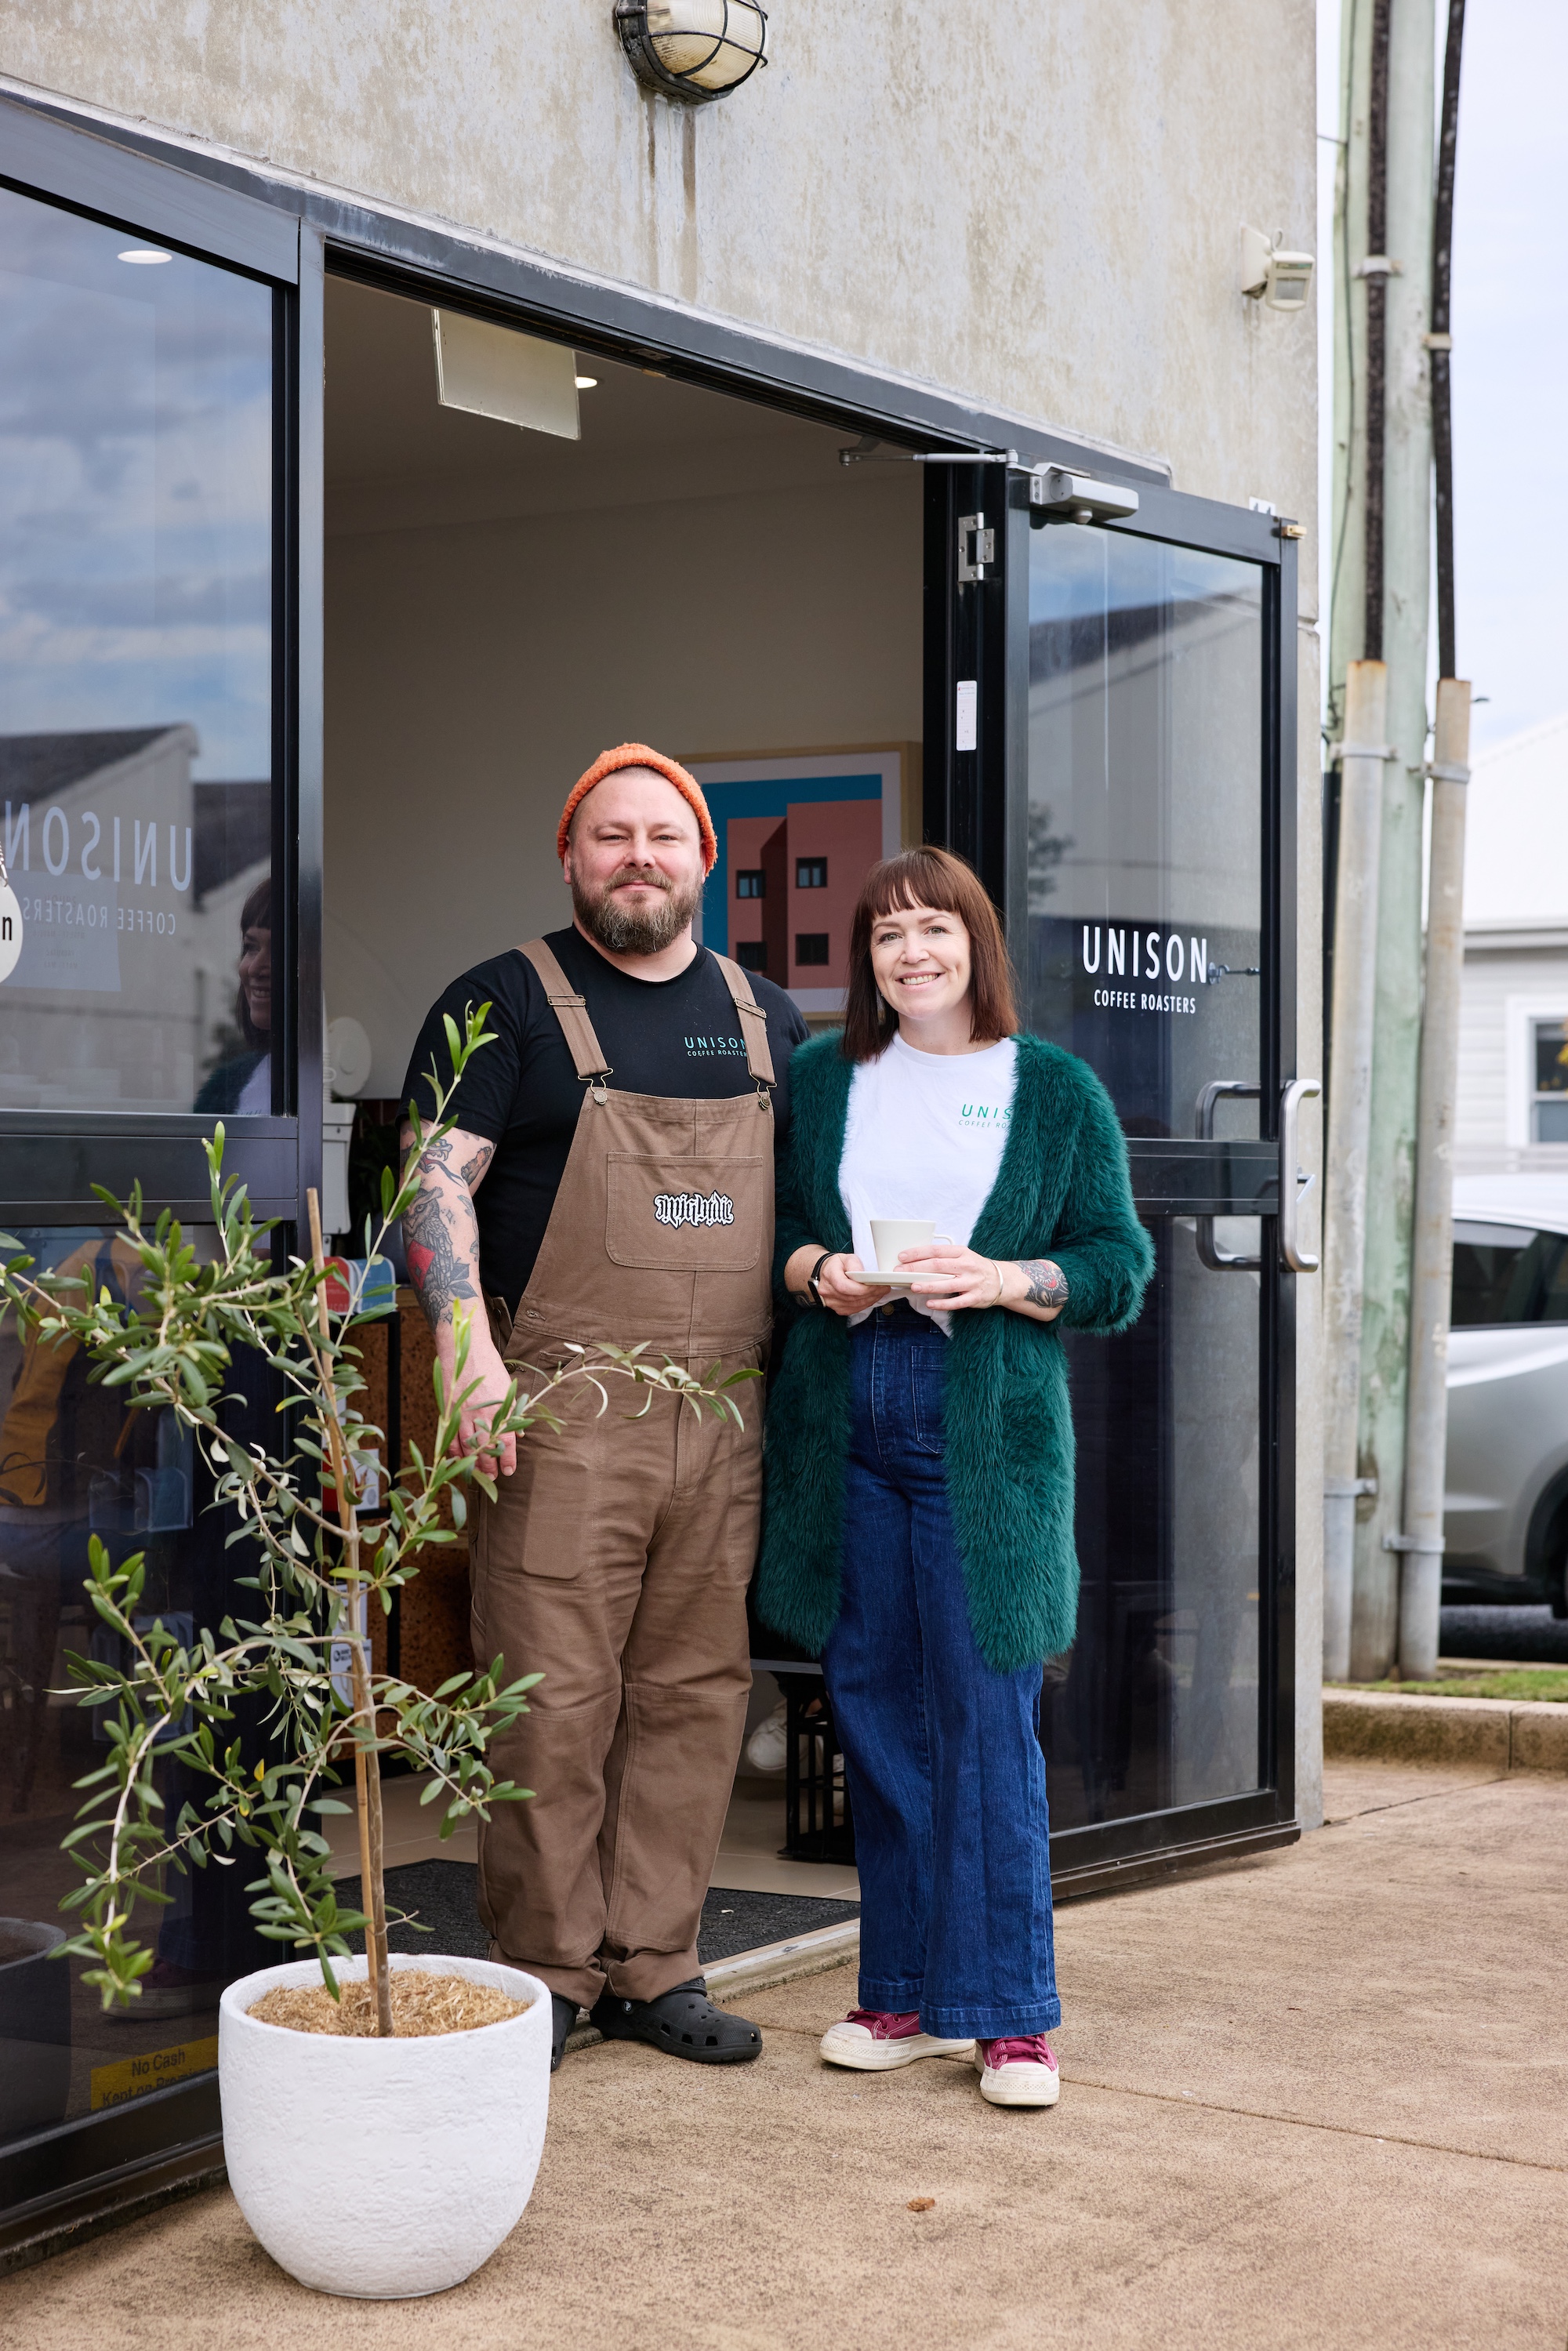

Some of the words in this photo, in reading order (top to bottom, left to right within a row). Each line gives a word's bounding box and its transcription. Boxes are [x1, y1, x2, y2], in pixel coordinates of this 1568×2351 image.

[1083, 925, 1207, 984] UNISON
[1094, 989, 1136, 1009] COFFEE
[1141, 993, 1196, 1014] ROASTERS
[958, 1119, 991, 1128] COFFEE
[961, 1104, 1012, 1119] UNIS
[132, 2060, 150, 2077] No
[153, 2048, 186, 2070] Cash
